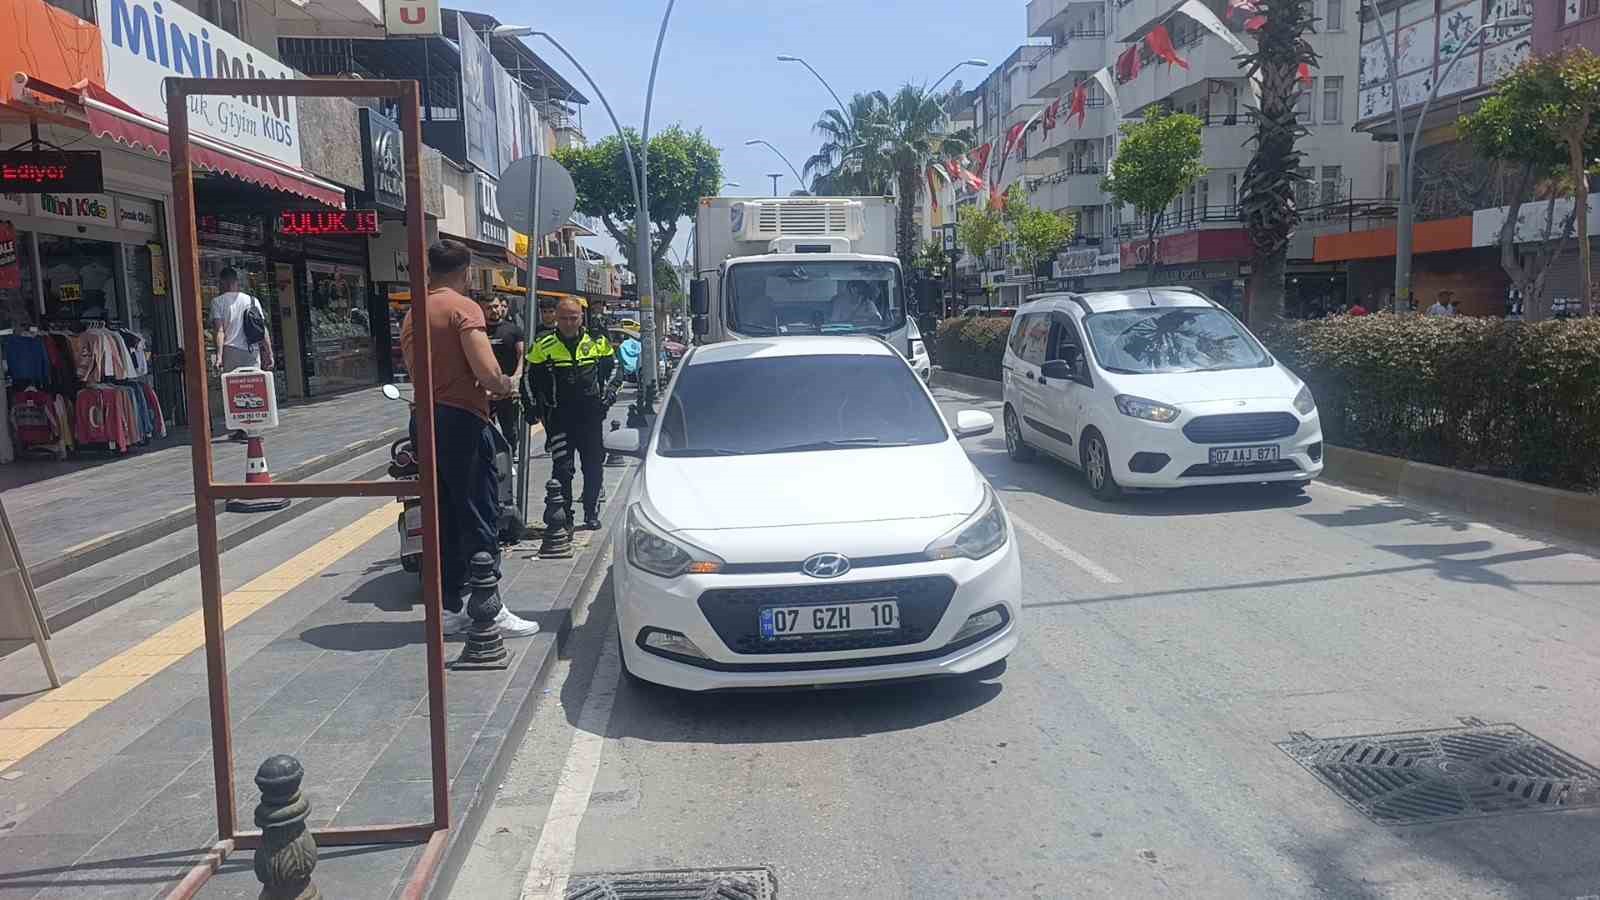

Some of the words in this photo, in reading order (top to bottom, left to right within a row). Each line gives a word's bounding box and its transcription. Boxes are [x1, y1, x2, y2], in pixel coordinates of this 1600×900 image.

[218, 101, 257, 138] Giyim
[262, 114, 293, 147] KIDS
[1217, 450, 1229, 462] 07
[1233, 448, 1252, 461] AAJ
[1258, 447, 1277, 460] 871
[774, 609, 800, 632] 07
[813, 606, 851, 630] GZH
[871, 604, 893, 626] 10
